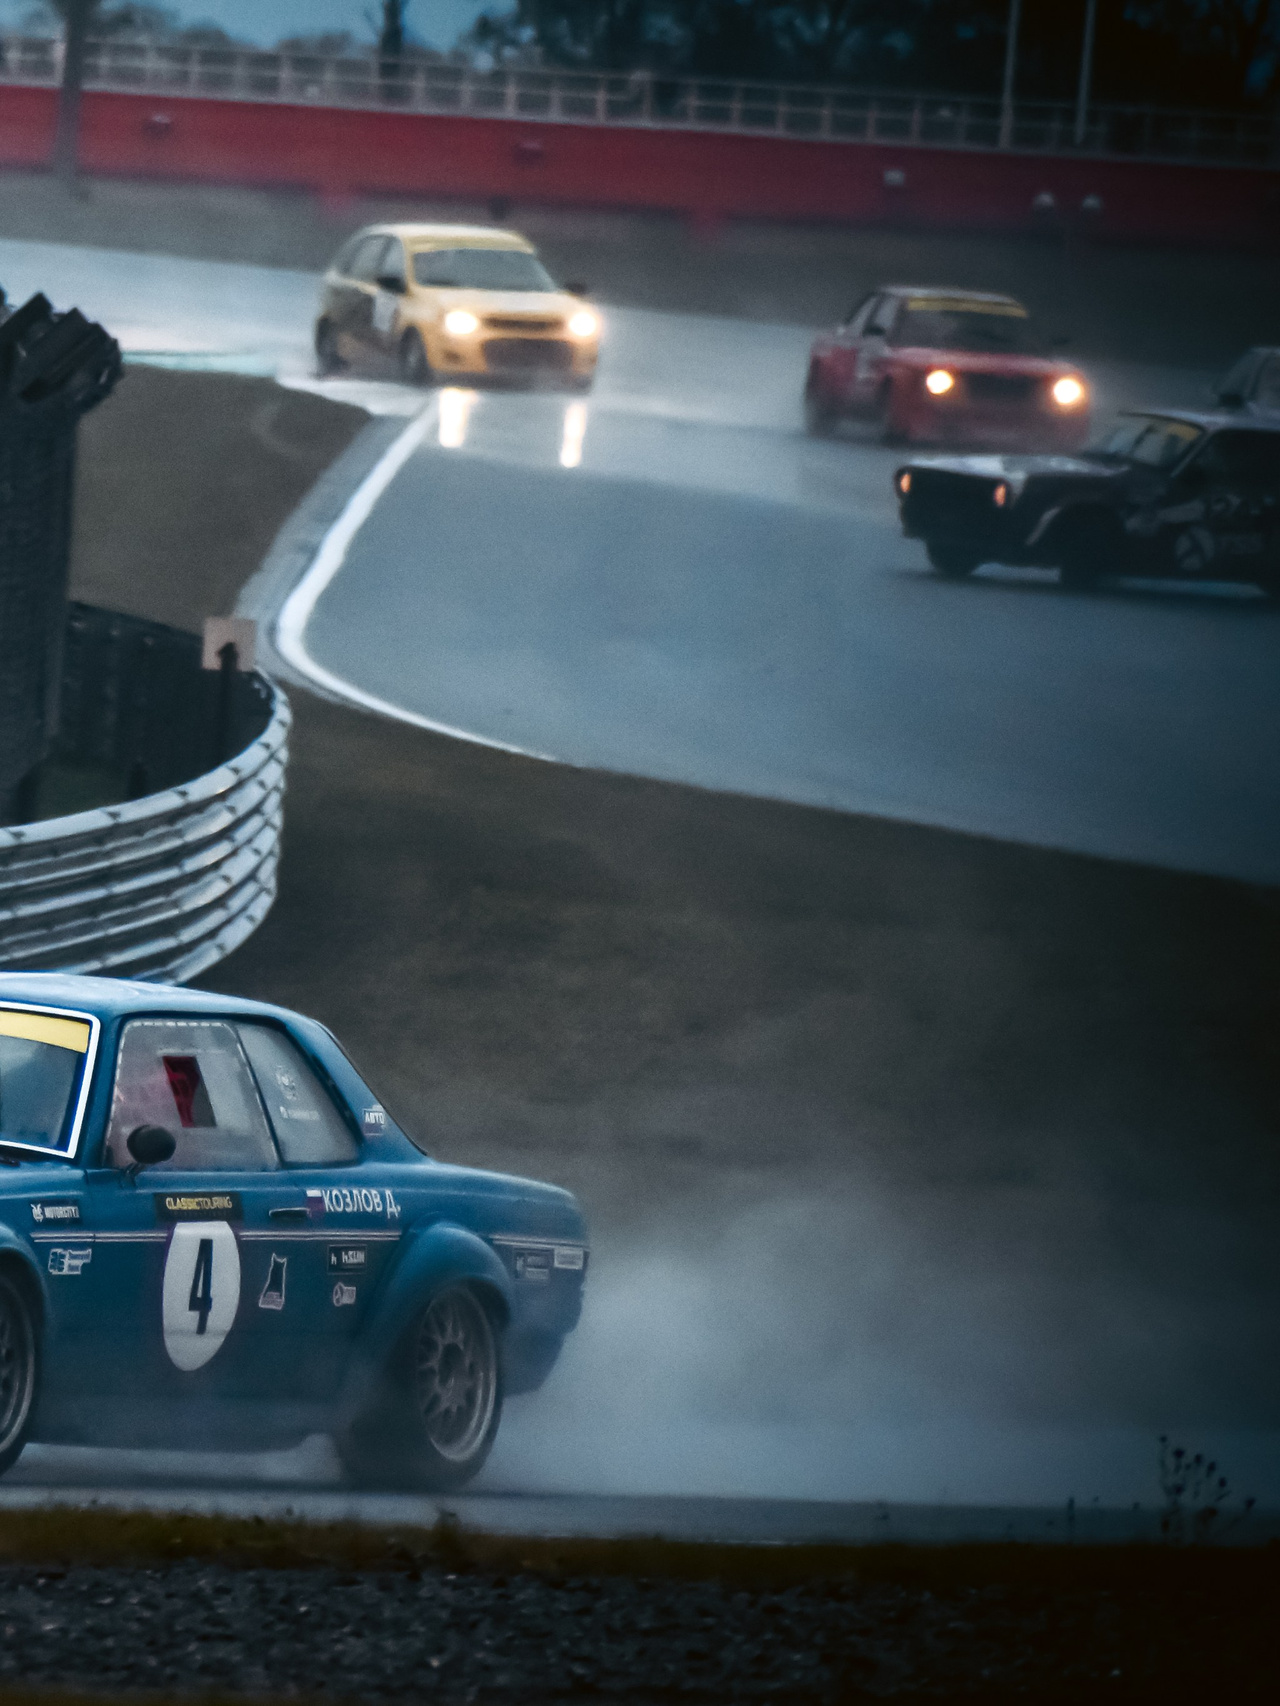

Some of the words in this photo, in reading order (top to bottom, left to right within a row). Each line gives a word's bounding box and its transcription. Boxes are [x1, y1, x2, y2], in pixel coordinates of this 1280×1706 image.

[322, 1188, 383, 1213] КОЗЛОВ
[384, 1188, 402, 1219] Д.
[188, 1238, 214, 1335] 4
